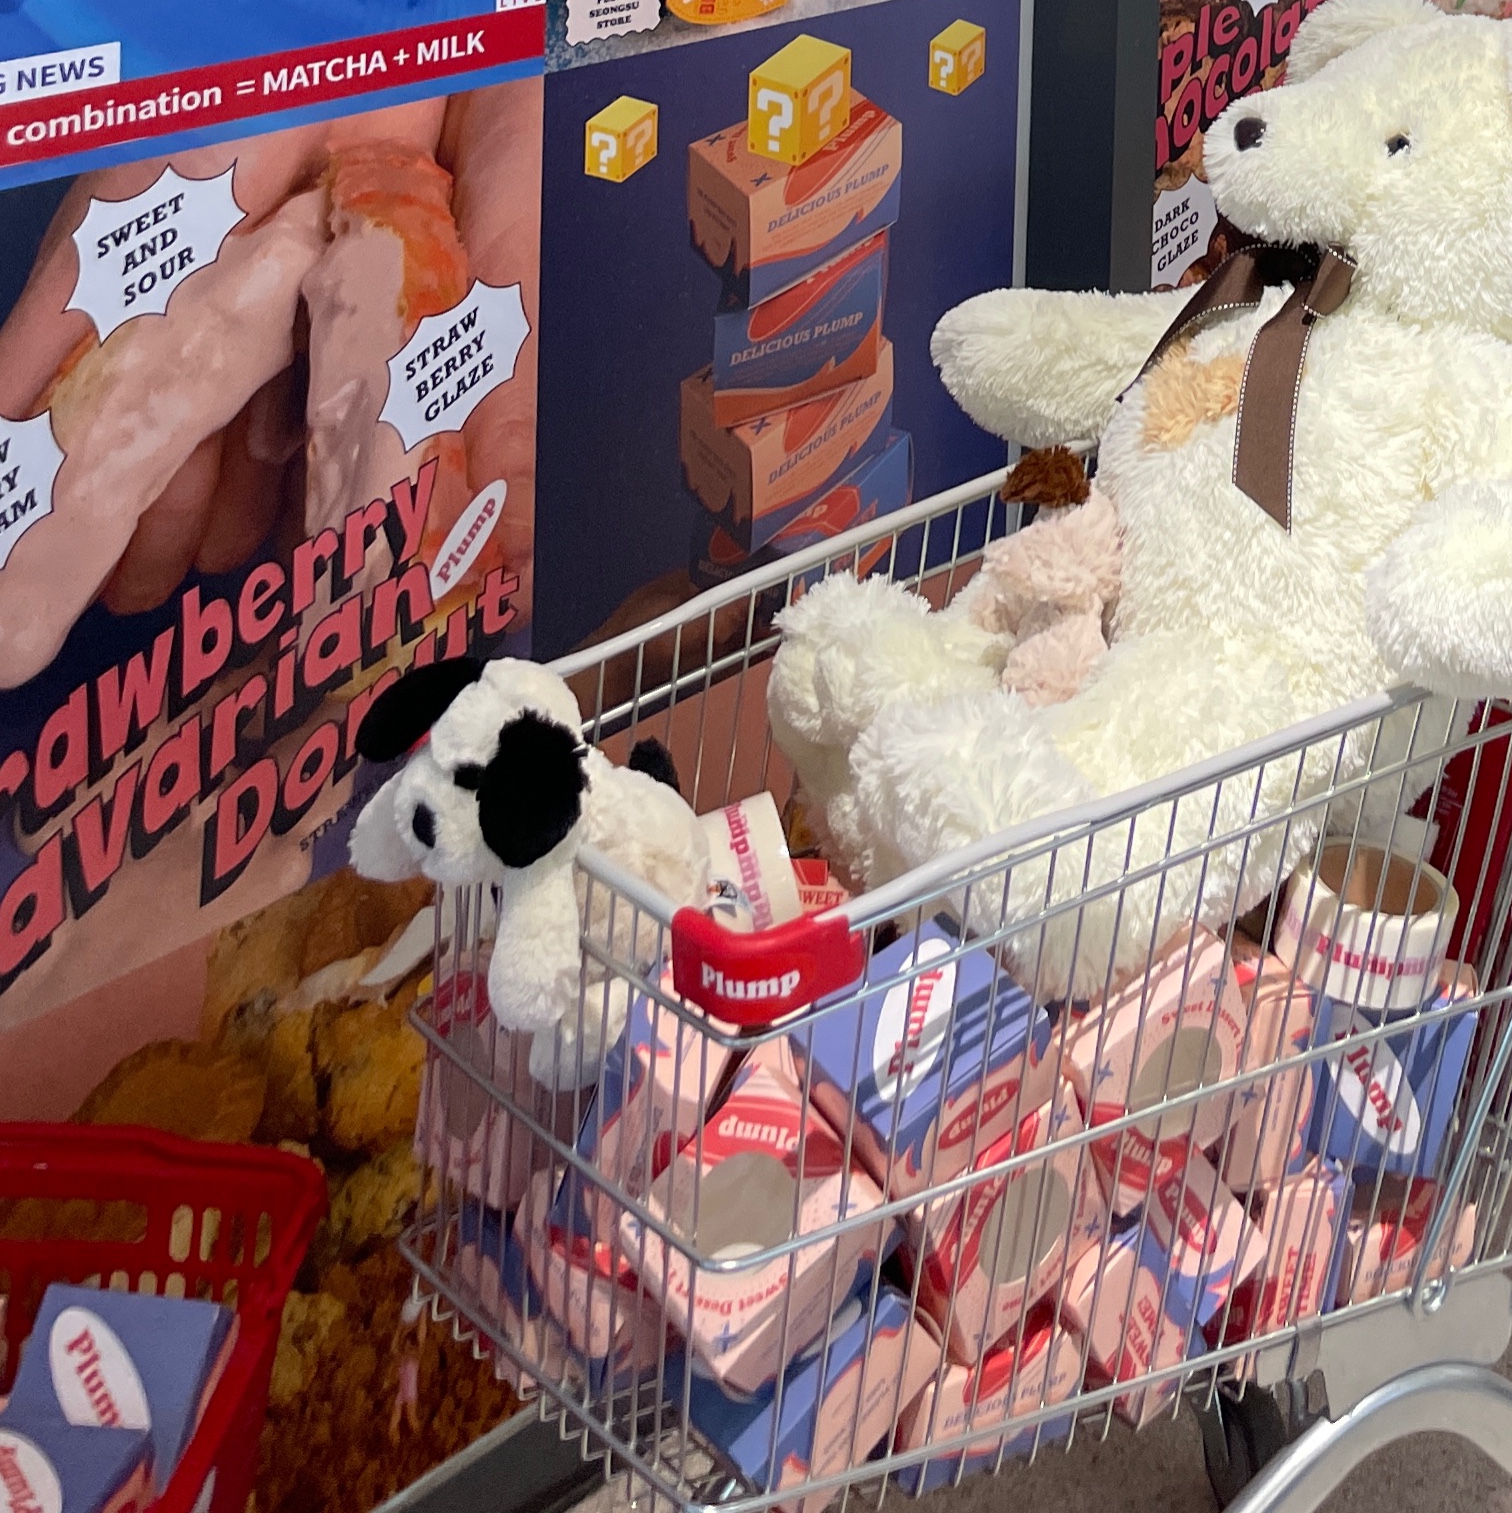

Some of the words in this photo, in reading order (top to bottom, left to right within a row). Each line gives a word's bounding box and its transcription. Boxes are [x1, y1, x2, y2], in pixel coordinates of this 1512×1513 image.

[596, 14, 632, 30] STORE
[7, 81, 222, 146] combination
[262, 49, 387, 96] MATCHA
[416, 29, 486, 65] MILK
[17, 56, 105, 92] NEWS
[96, 192, 185, 260] SWEET
[767, 187, 842, 234] DELICIOUS
[844, 163, 890, 195] PLUMP
[1154, 197, 1190, 233] DARK
[121, 227, 180, 277] AND
[1152, 211, 1199, 256] CHOCO
[1157, 229, 1199, 273] GLAZE
[123, 246, 196, 307] SOUR
[404, 306, 482, 383] STRAW
[415, 330, 487, 404] BERRY
[730, 329, 811, 367] DELICIOUS
[813, 311, 864, 342] PLUMP
[424, 352, 495, 424] GLAZE
[767, 421, 838, 486] DELICIOUS
[839, 391, 882, 431] PLUMP
[436, 495, 498, 586] Plump
[701, 960, 800, 1000] Plump
